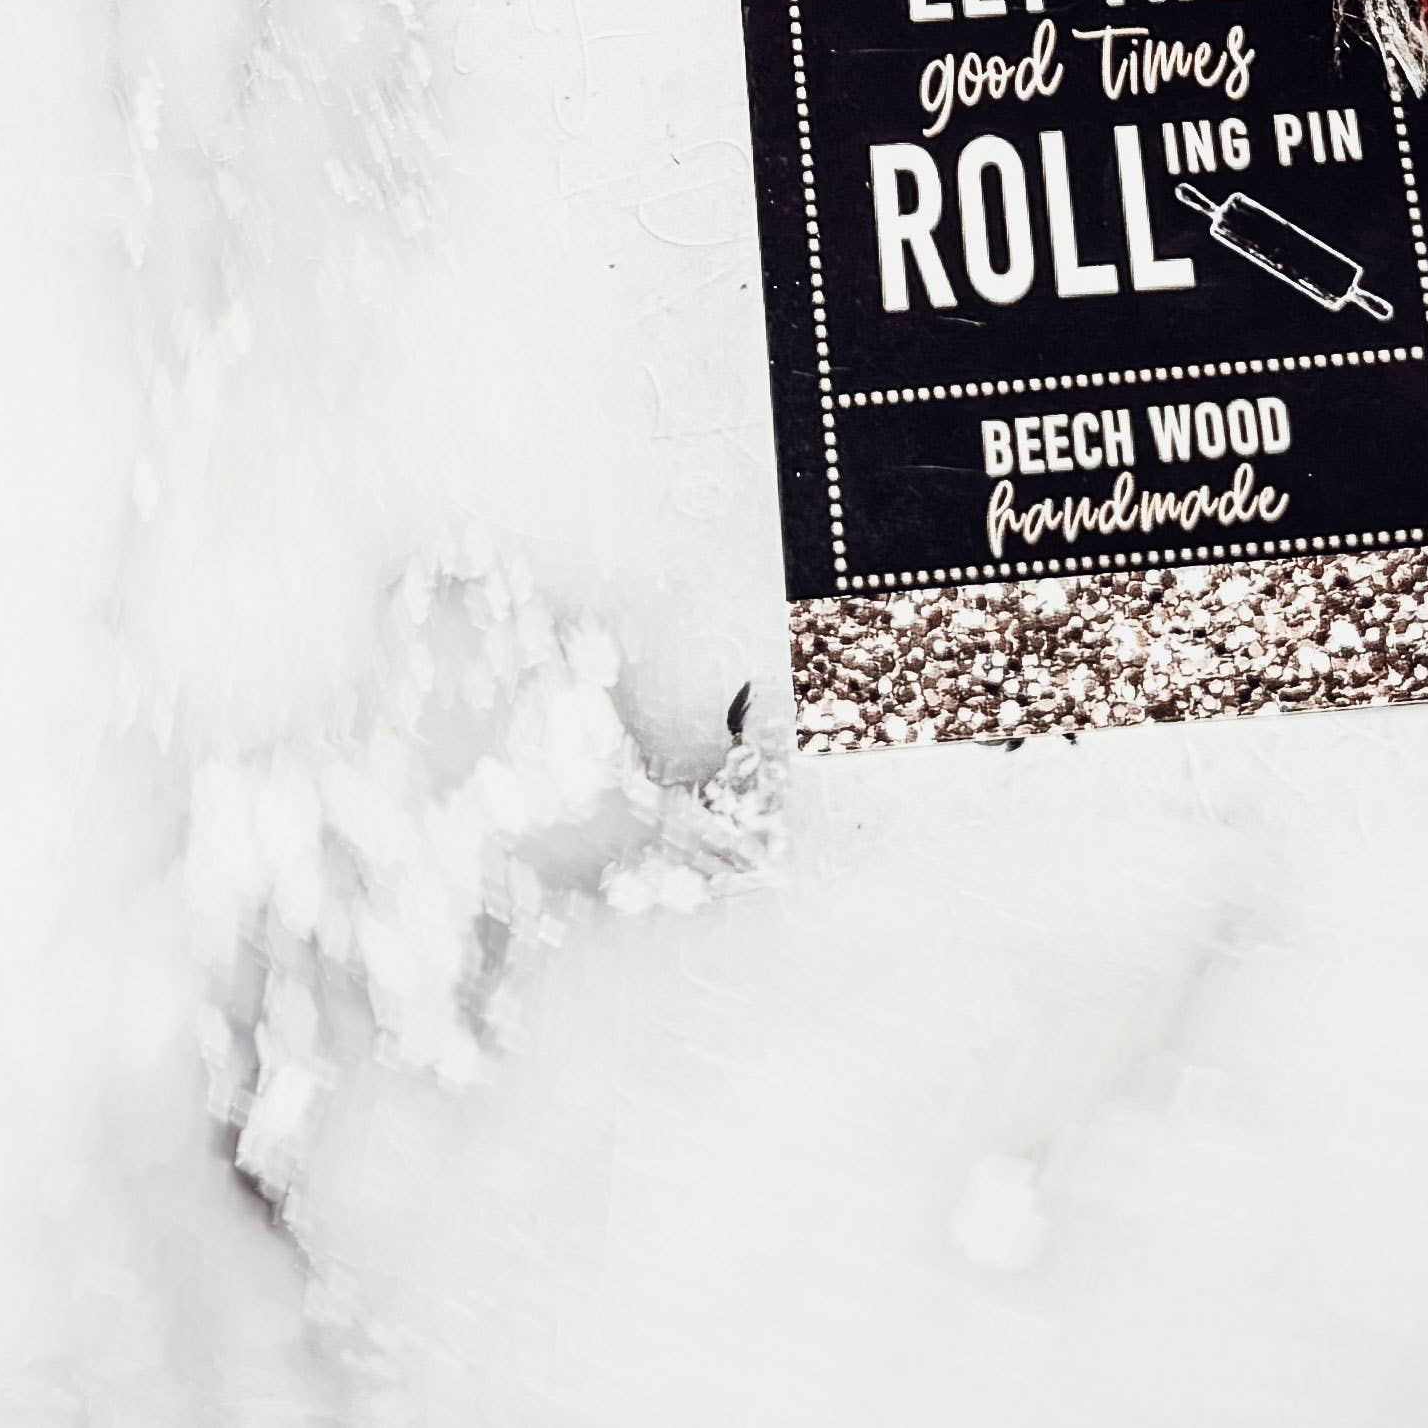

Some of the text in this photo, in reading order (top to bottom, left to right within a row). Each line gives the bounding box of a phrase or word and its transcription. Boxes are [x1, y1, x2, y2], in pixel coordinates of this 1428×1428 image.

[919, 18, 1064, 138] good
[1273, 108, 1364, 166] PIN
[981, 396, 1292, 477] BEECH WOOD
[986, 463, 1292, 558] handmade
